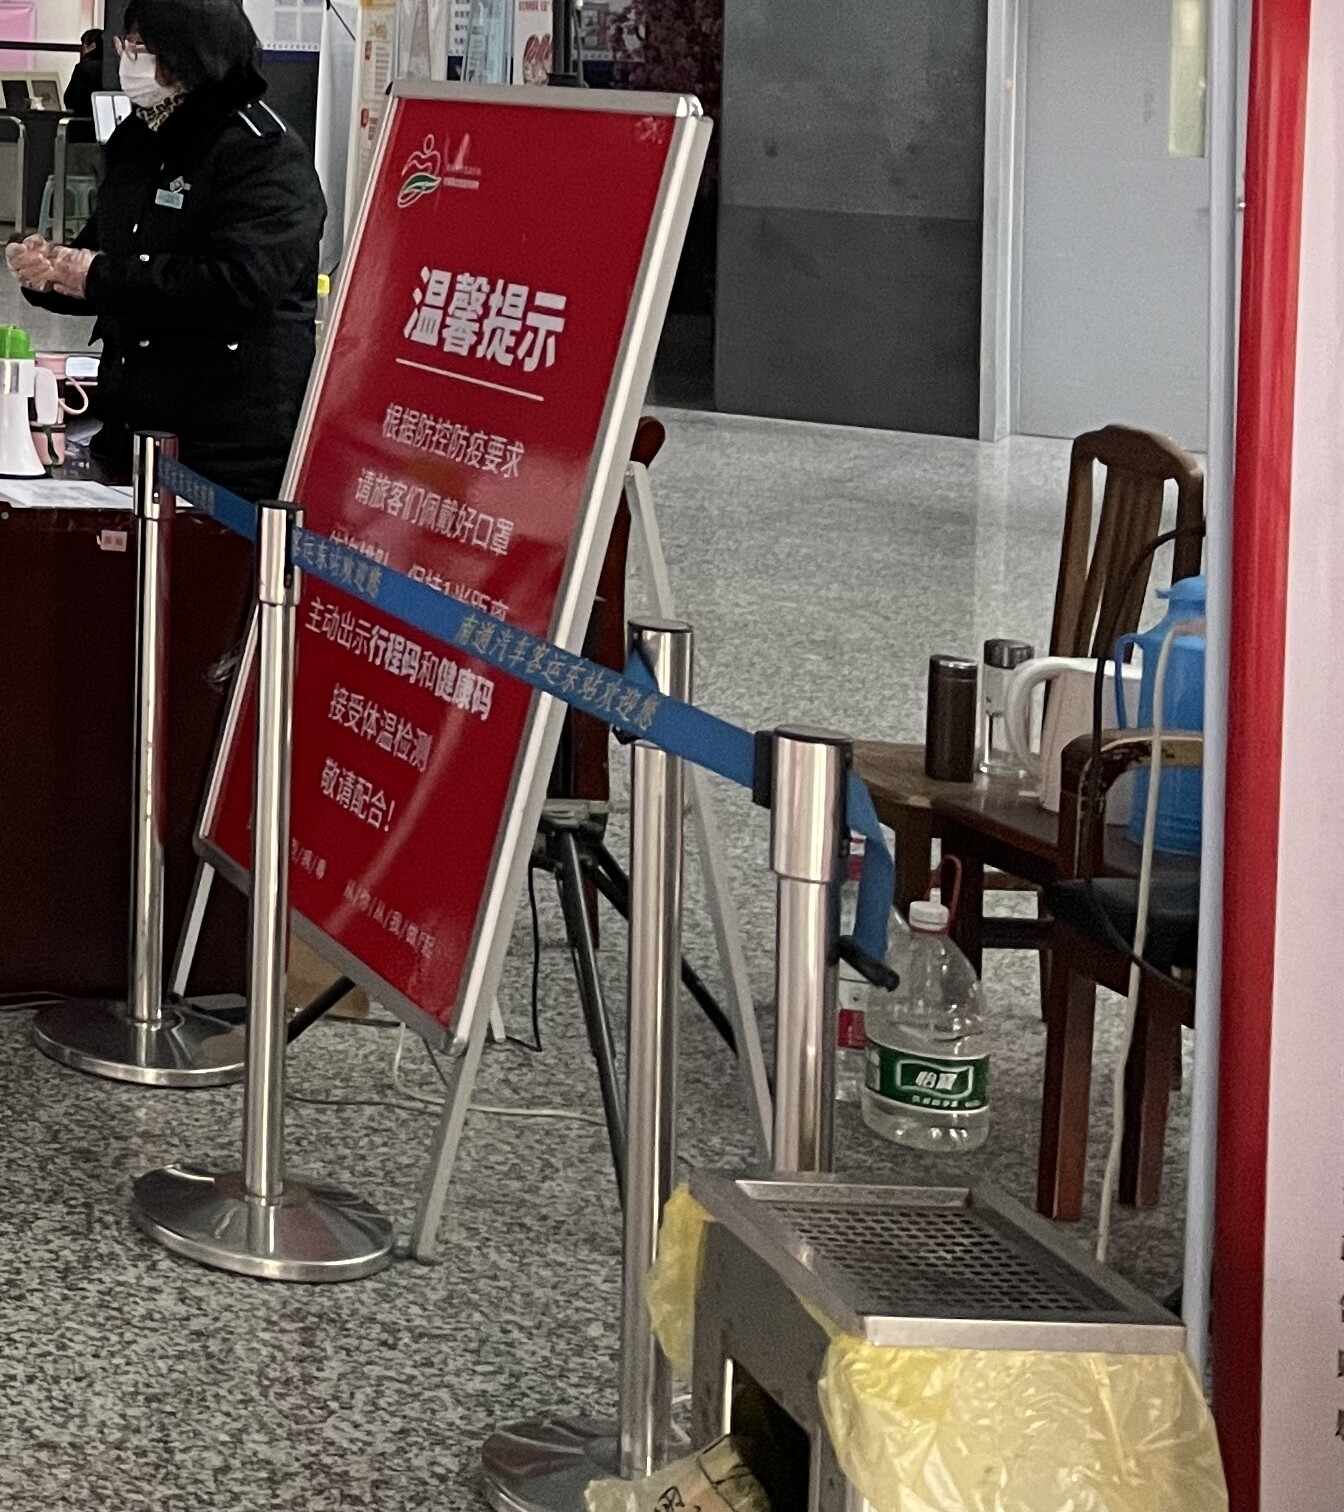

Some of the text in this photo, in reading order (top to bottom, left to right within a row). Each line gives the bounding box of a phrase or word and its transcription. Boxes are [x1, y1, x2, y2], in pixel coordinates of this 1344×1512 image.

[404, 265, 567, 373] 温馨提示
[381, 402, 526, 479] 根据防控防疫要求
[355, 467, 515, 558] 请旅客们佩戴好口罩
[305, 596, 496, 722] 主动出示行程码和健康码
[327, 682, 434, 773] 接受体温检测
[319, 757, 397, 832] 敬请配合！
